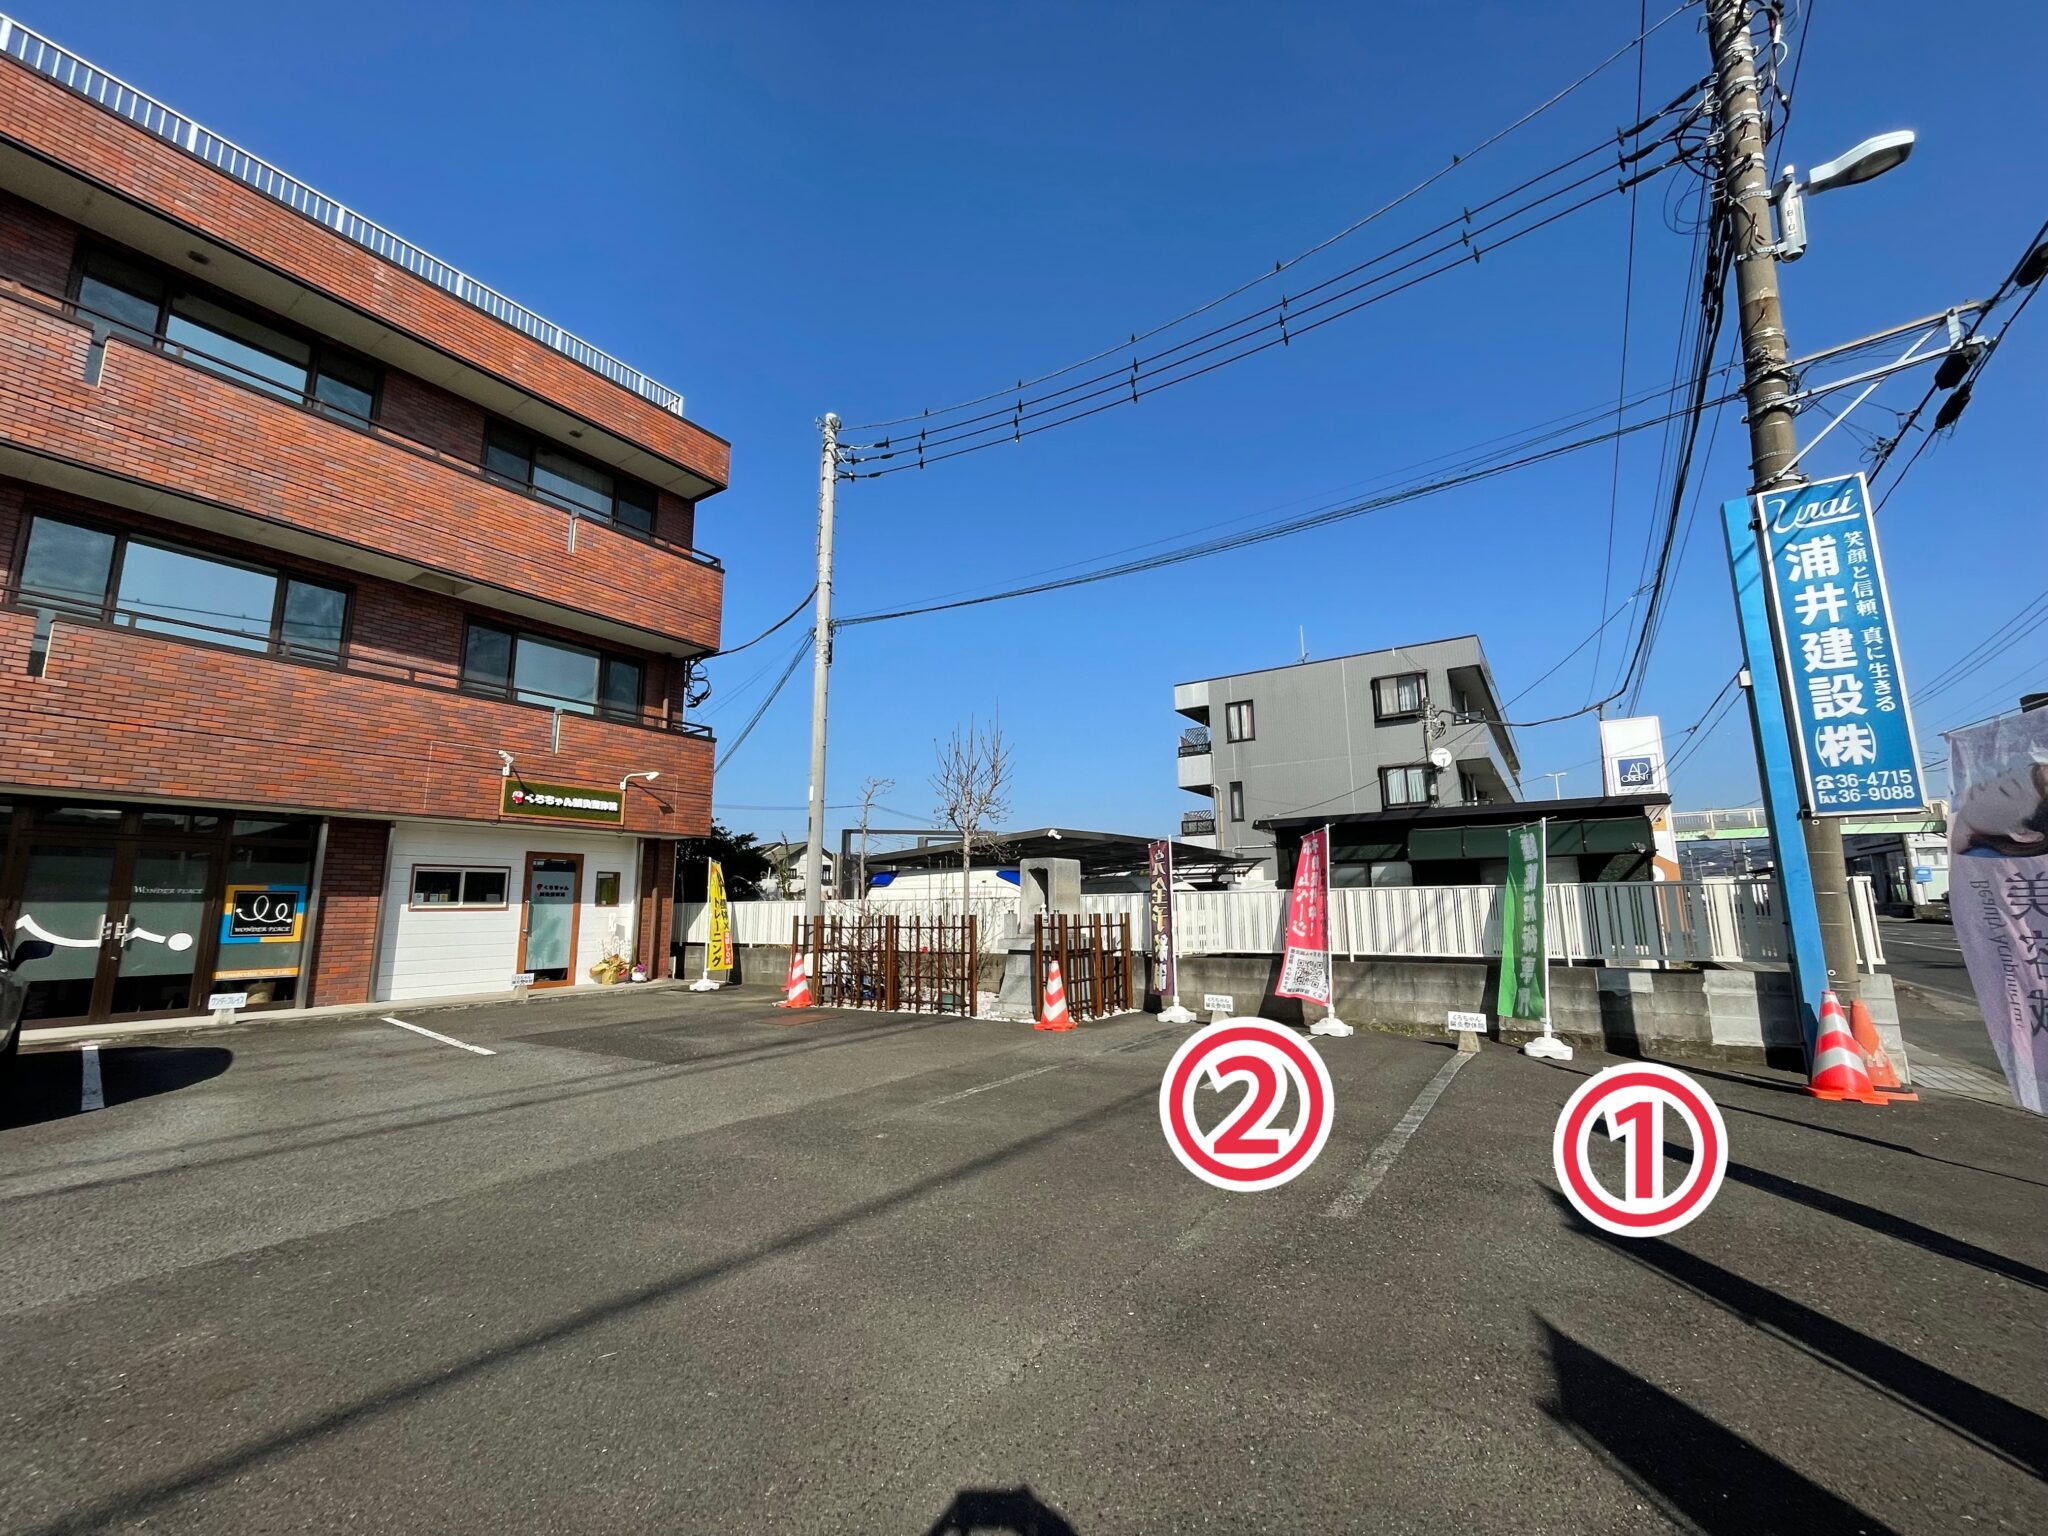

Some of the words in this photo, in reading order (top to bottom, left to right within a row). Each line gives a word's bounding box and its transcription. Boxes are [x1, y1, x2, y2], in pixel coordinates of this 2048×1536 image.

[1843, 530, 1896, 713] 笑顔と信頼、真に生きる
[1838, 785, 1915, 803] 36-9088
[711, 897, 723, 968] トレーニング
